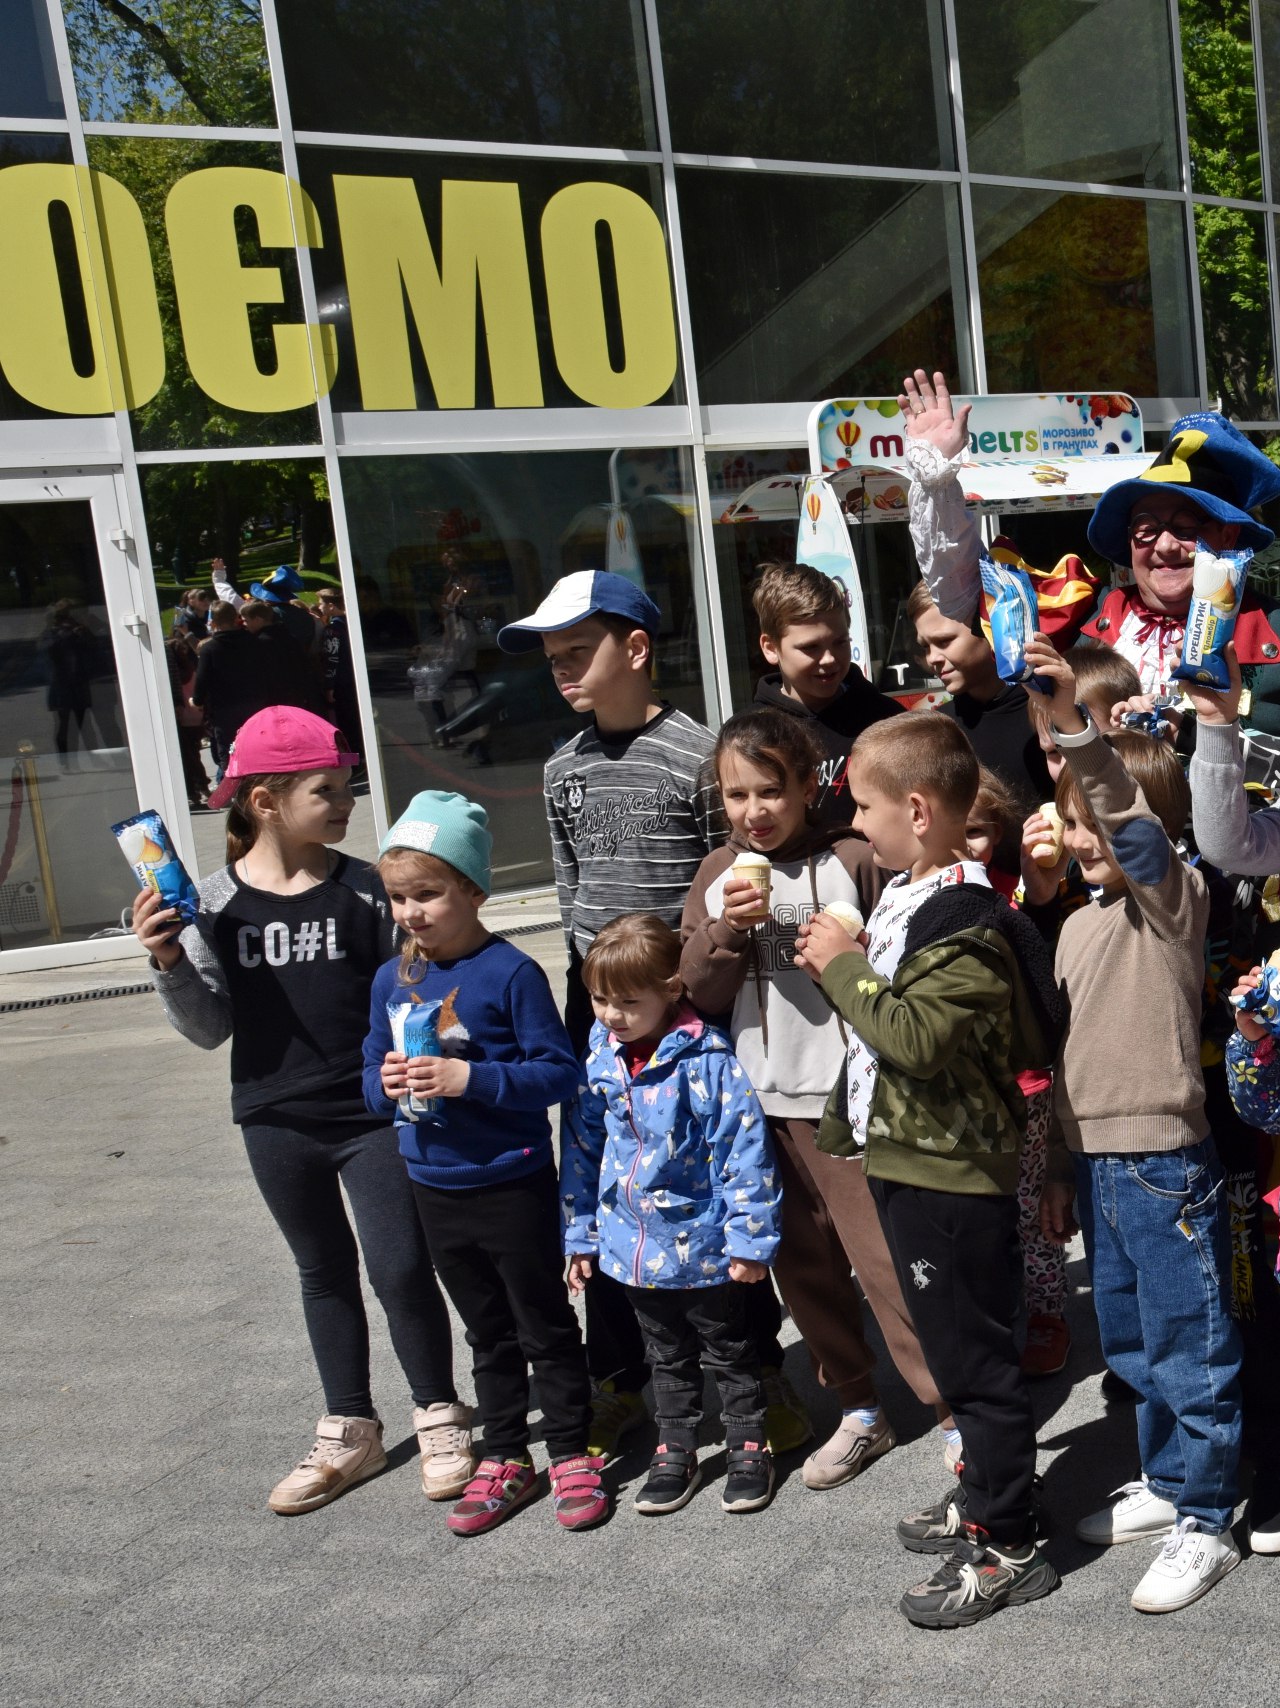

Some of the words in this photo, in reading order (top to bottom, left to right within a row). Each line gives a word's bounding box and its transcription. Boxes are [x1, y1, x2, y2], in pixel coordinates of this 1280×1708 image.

[0, 163, 678, 415] ОЄМО
[1042, 427, 1095, 440] МОРОЗИВО
[1043, 440, 1050, 451] В
[1052, 438, 1098, 451] ГРАНУЛАХ
[1190, 601, 1207, 662] ХРЕЩАТИК
[1203, 619, 1216, 651] Пломбір
[237, 917, 347, 968] CO#L
[567, 1459, 592, 1470] SPORT
